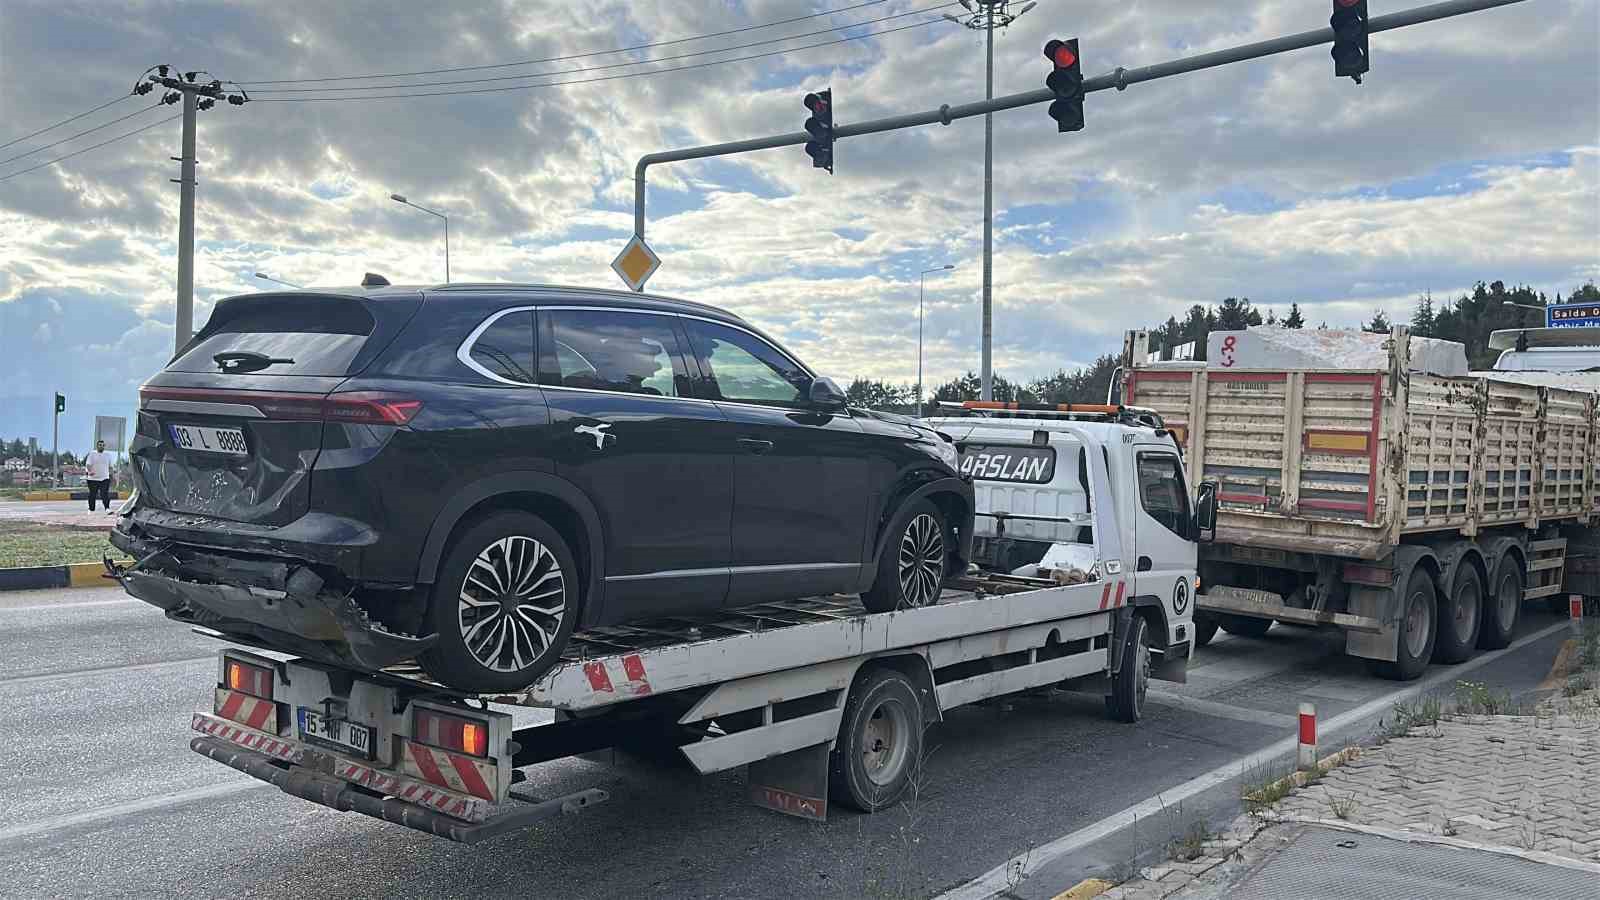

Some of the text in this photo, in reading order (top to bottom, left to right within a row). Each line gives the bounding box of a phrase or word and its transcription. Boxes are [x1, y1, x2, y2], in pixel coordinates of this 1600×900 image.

[1554, 309, 1586, 318] Salda
[176, 427, 193, 447] 03
[198, 428, 211, 449] L
[960, 453, 1049, 481] ARSLAN
